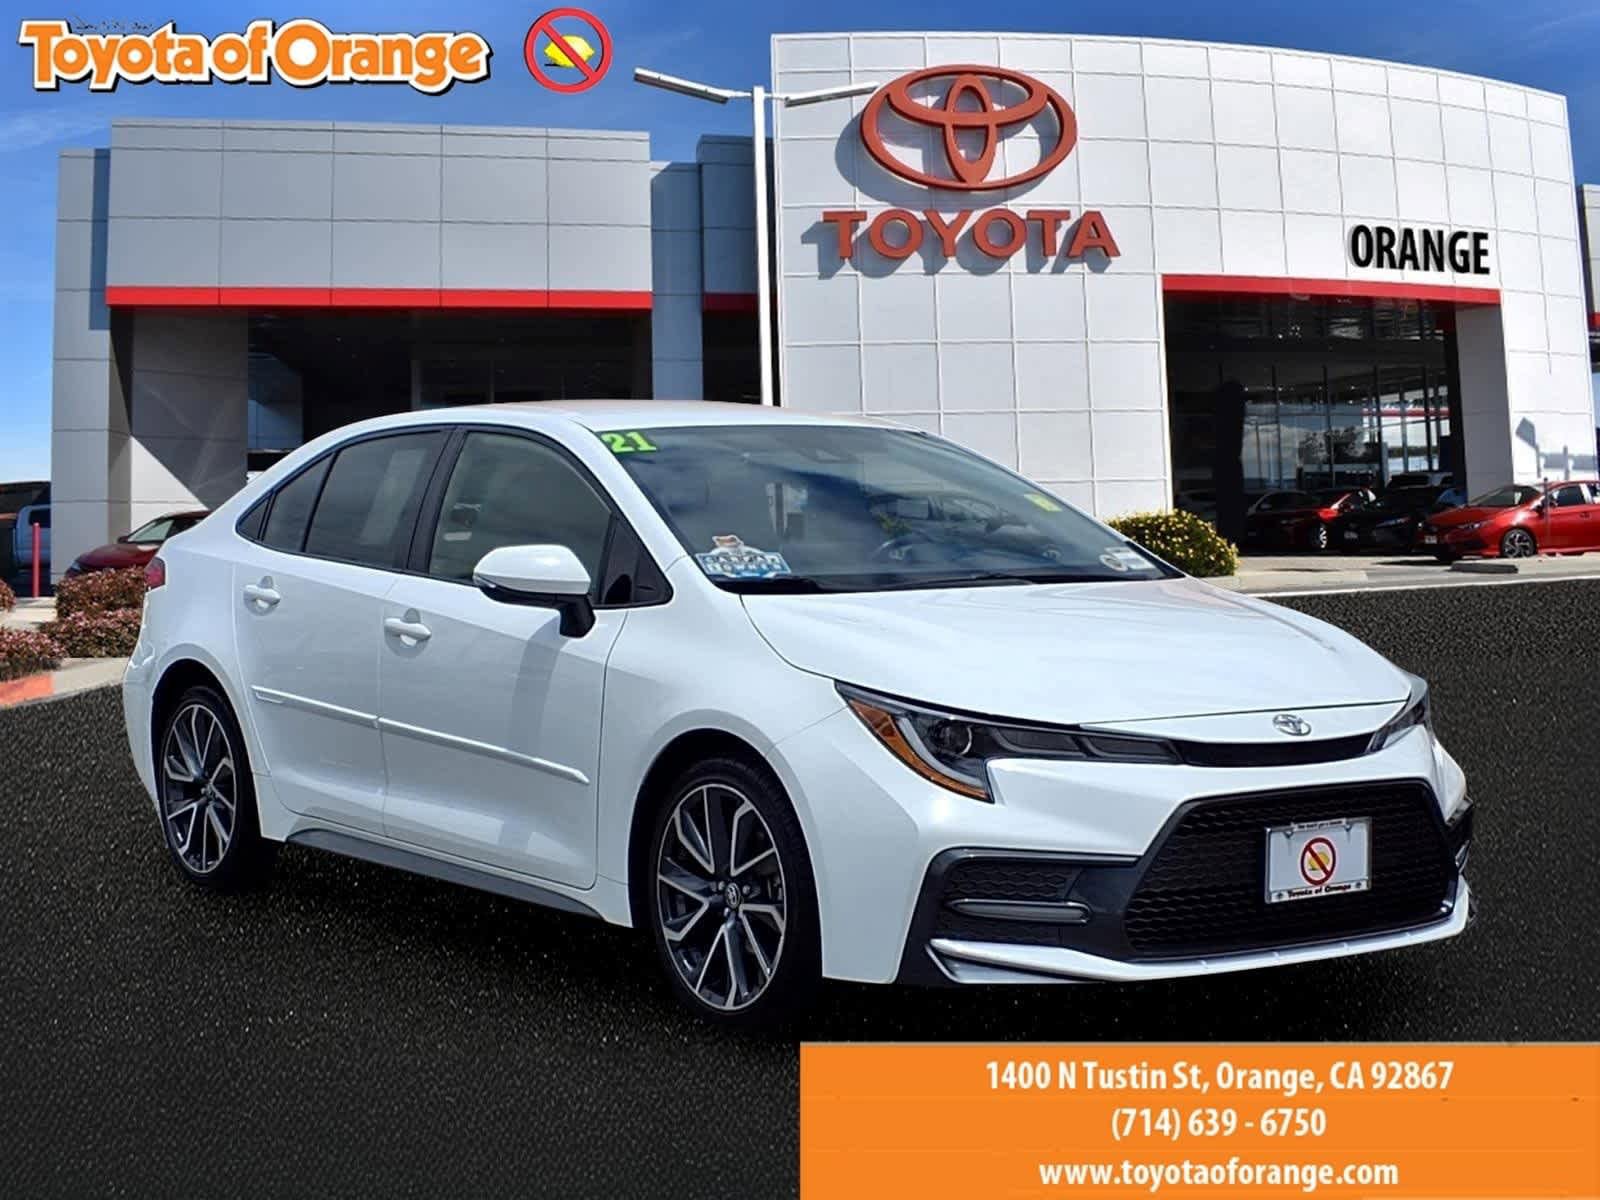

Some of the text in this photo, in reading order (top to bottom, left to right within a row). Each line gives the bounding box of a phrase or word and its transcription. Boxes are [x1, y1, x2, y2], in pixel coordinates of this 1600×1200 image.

[822, 208, 1120, 260] TOYOTA
[1350, 224, 1490, 275] ORANGE
[601, 431, 657, 454] 21
